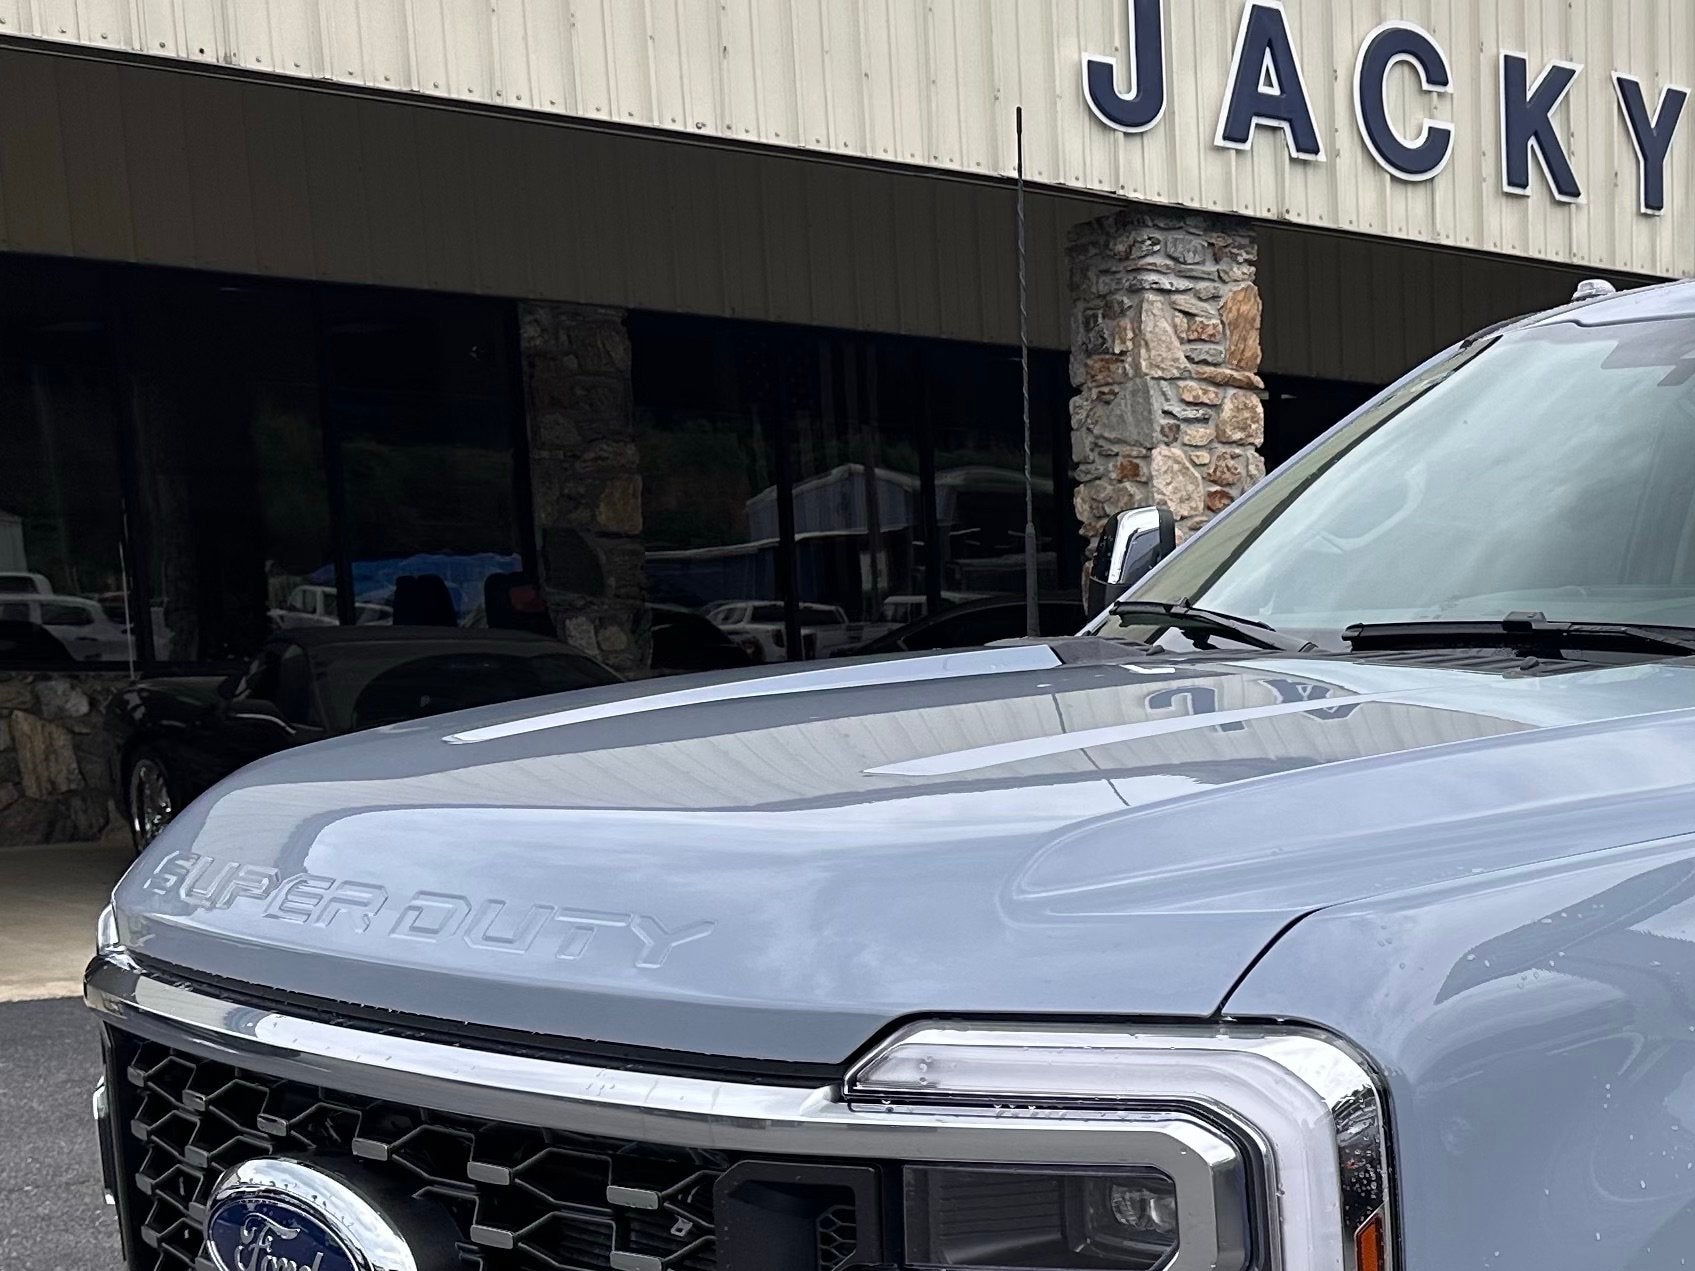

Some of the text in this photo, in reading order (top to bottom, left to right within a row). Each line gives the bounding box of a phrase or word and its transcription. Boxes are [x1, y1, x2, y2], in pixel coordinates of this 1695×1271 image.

[1082, 0, 1691, 218] JACKY
[143, 850, 714, 969] SUPER DUTY
